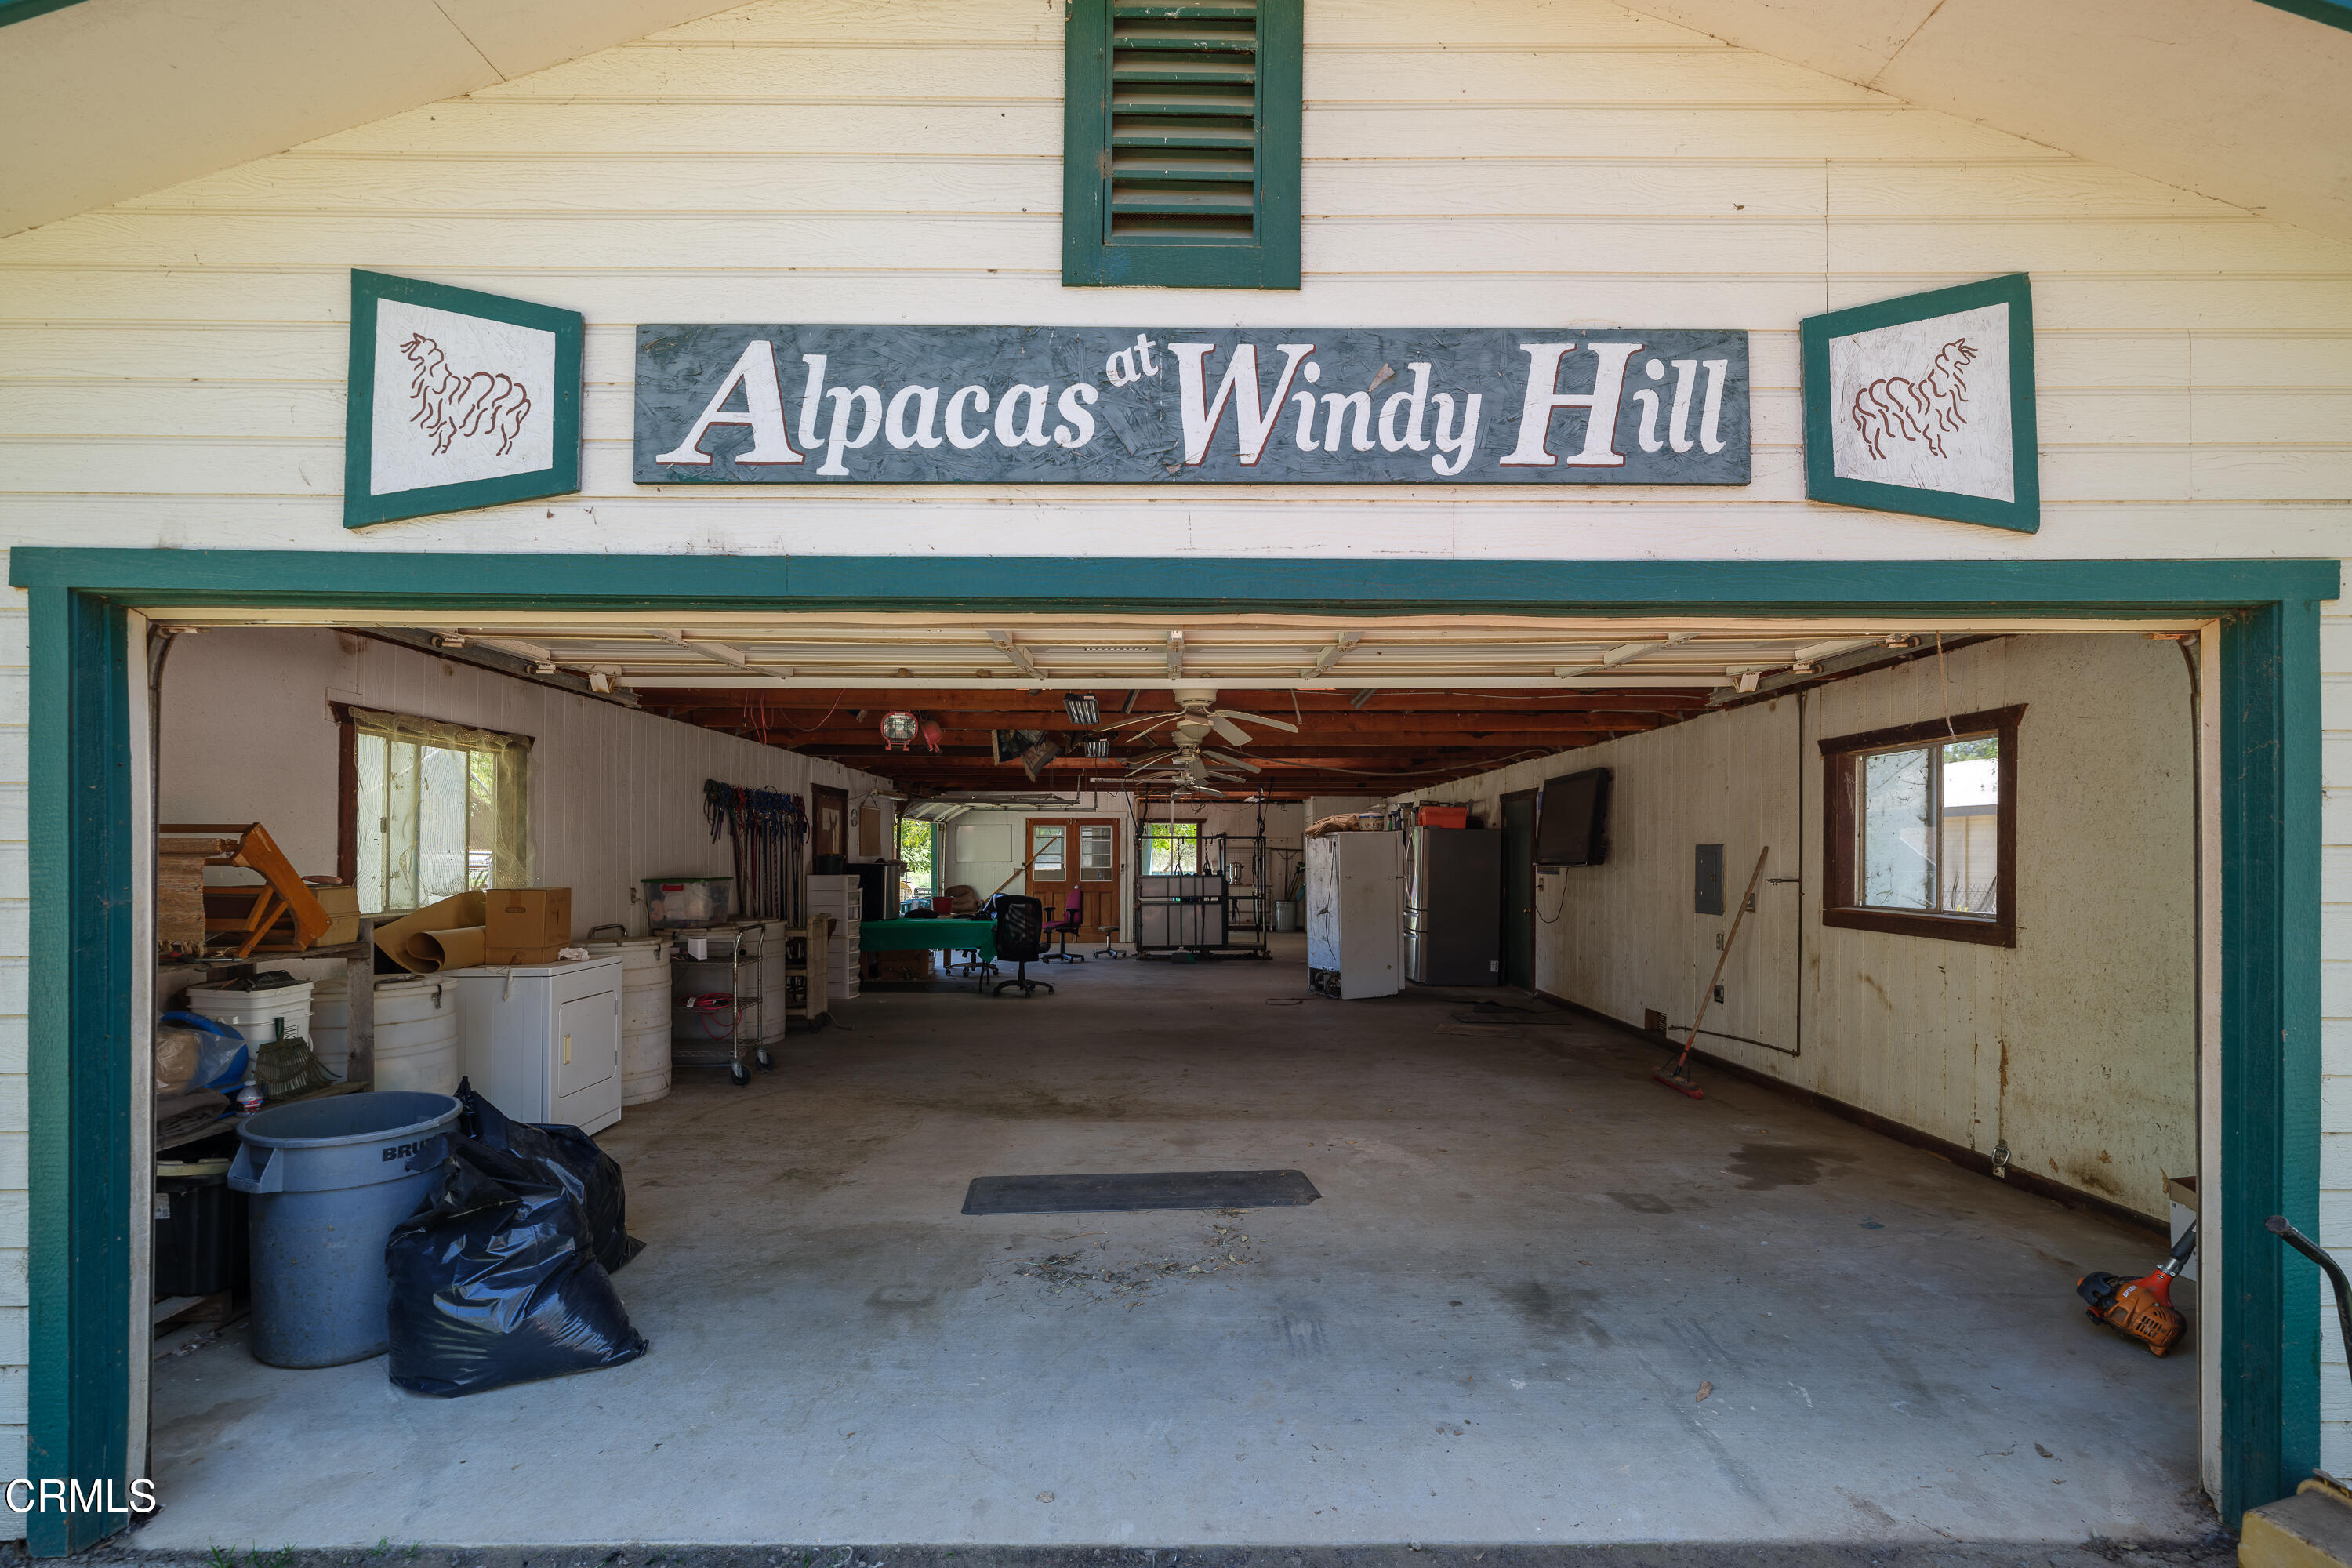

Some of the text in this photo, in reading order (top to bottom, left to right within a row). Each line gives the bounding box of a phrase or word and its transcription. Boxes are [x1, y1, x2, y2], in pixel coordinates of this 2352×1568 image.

[655, 333, 1728, 476] Alpacas at Windy Hill
[382, 1138, 431, 1162] BRU
